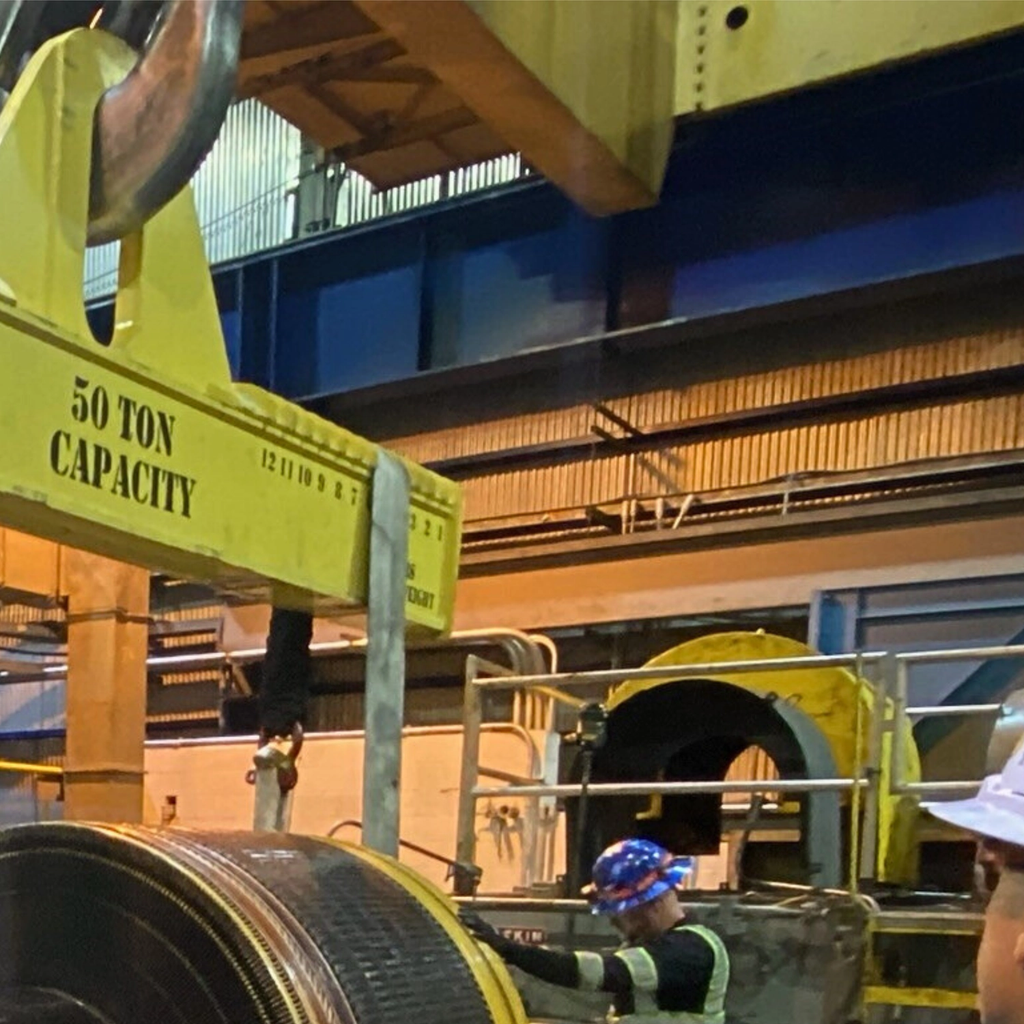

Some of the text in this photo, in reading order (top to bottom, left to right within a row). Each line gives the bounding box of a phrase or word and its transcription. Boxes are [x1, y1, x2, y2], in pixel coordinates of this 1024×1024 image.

[70, 375, 176, 457] 50 TON
[49, 429, 197, 519] CAPACITY
[261, 448, 276, 472] 12
[280, 457, 294, 480] 11
[298, 464, 313, 487] 10
[317, 472, 326, 493] 9
[334, 480, 343, 500] 8
[351, 486, 358, 506] 7
[424, 518, 431, 537] 2
[437, 524, 443, 541] 1
